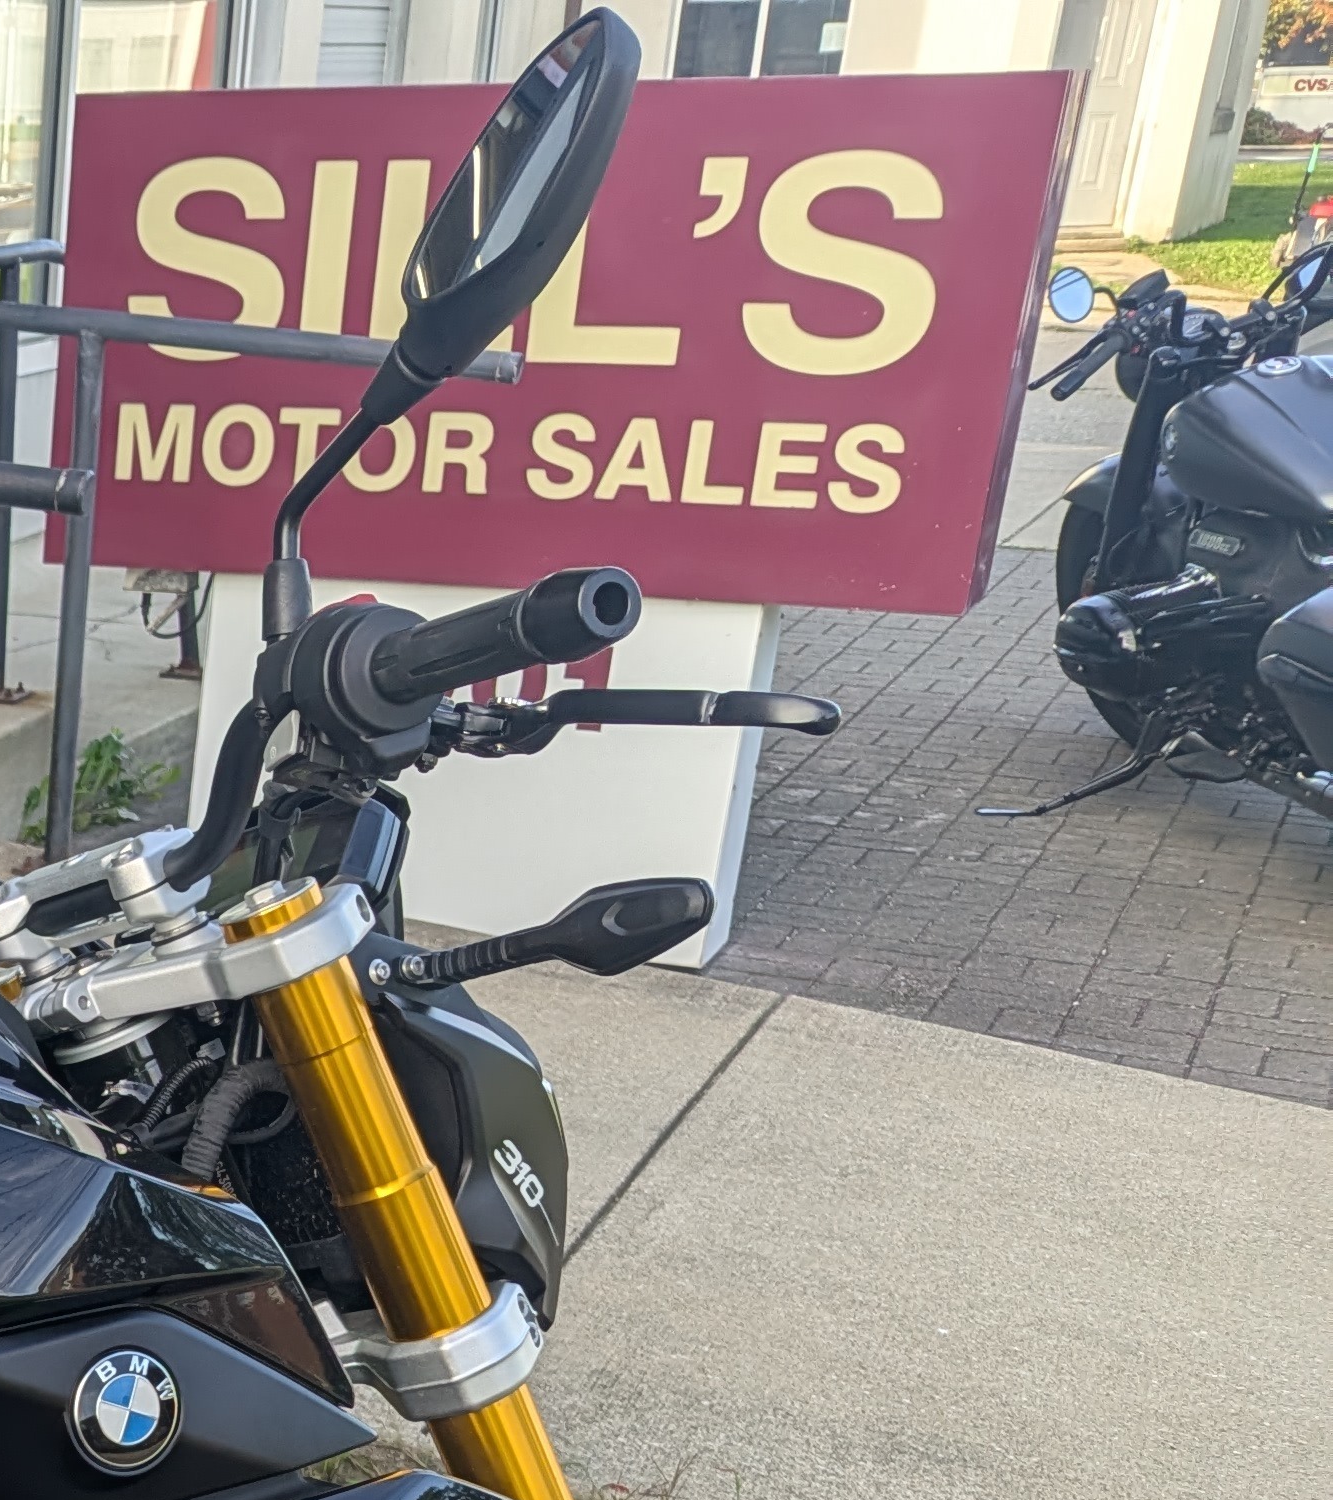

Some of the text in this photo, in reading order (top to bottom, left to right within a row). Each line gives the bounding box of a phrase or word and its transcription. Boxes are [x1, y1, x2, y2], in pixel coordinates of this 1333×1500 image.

[115, 402, 907, 515] MOTOR SALES
[492, 1139, 546, 1208] 310
[95, 1355, 176, 1401] BMW
